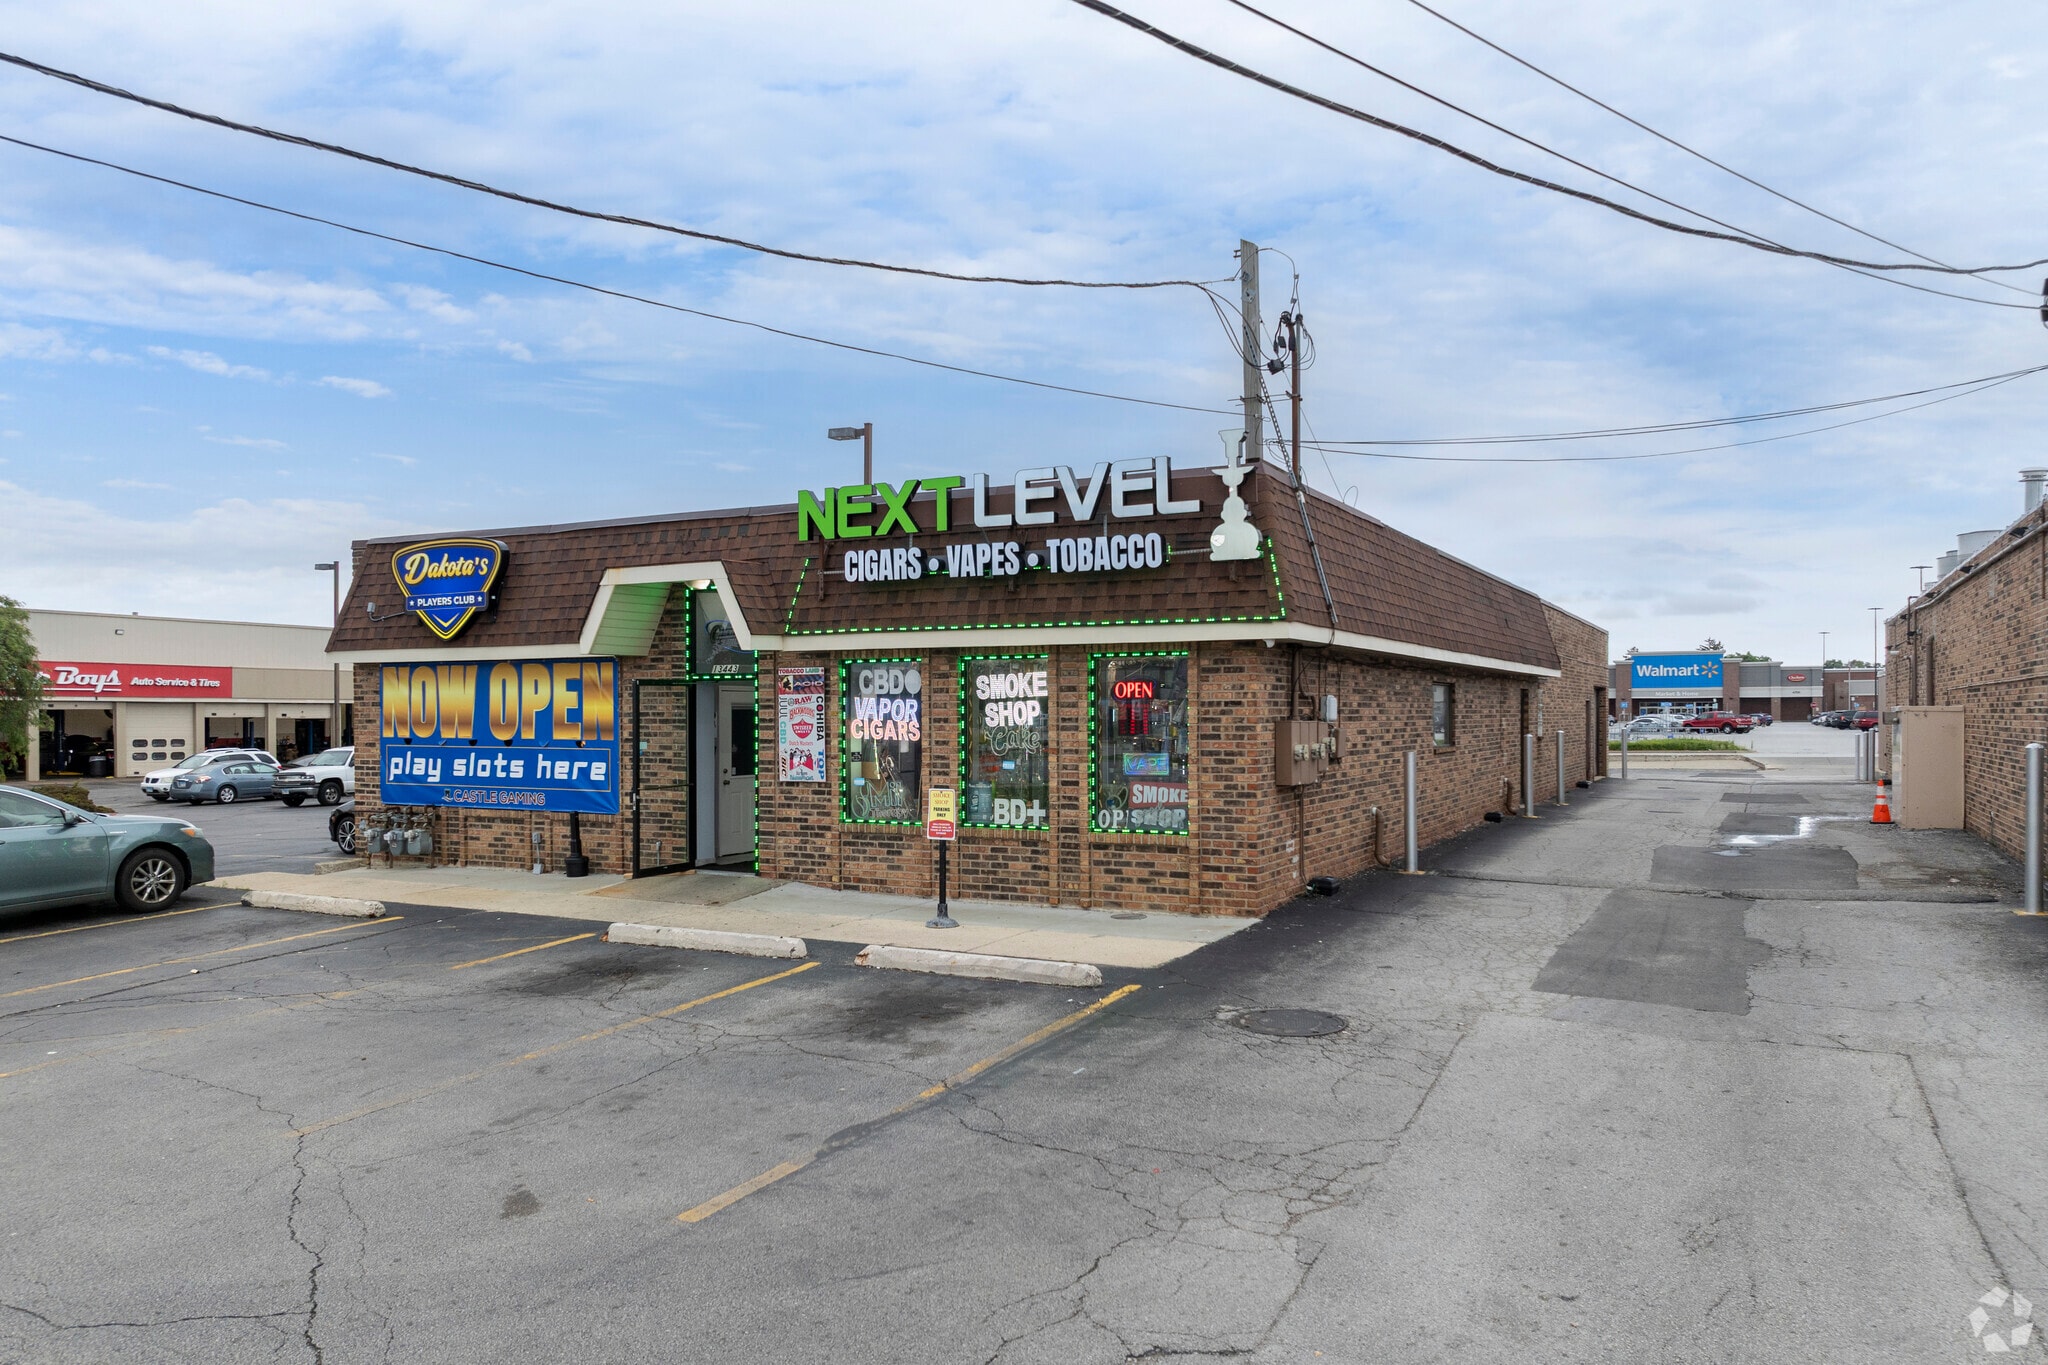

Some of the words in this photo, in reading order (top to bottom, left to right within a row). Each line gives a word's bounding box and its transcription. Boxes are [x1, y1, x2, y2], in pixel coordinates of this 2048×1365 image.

[798, 476, 965, 541] NEXT
[973, 455, 1201, 528] LEVEL
[404, 553, 489, 584] Dakota's
[844, 546, 923, 582] CIGARS
[946, 541, 1021, 578] VAPES
[1046, 533, 1163, 573] TOBACCO
[417, 597, 452, 607] PLAYERS
[453, 595, 475, 605] CLUB
[55, 666, 123, 693] Boys
[130, 677, 154, 686] Auto
[155, 678, 188, 687] Service
[190, 679, 197, 687] &
[198, 678, 220, 687] Tires
[712, 665, 739, 673] 13443
[858, 669, 905, 695] CBD
[1636, 664, 1700, 677] Walmart
[976, 671, 1049, 700] SMOKE
[1114, 681, 1153, 698] OPEN
[382, 664, 478, 739] NOW
[488, 662, 614, 740] OPEN
[794, 695, 812, 705] RAW
[854, 696, 918, 722] VAPOR
[816, 696, 825, 741] COHIBA
[985, 700, 1041, 727] SHOP
[850, 718, 921, 741] CIGARS
[985, 723, 1041, 756] Cake
[388, 750, 442, 783] play
[452, 752, 525, 778] slots
[536, 753, 607, 781] here
[1126, 757, 1167, 770] VAPE
[453, 789, 497, 804] CASTLE
[499, 791, 546, 806] GAMING
[1132, 783, 1189, 804] SMOKE
[990, 798, 1046, 826] BD+
